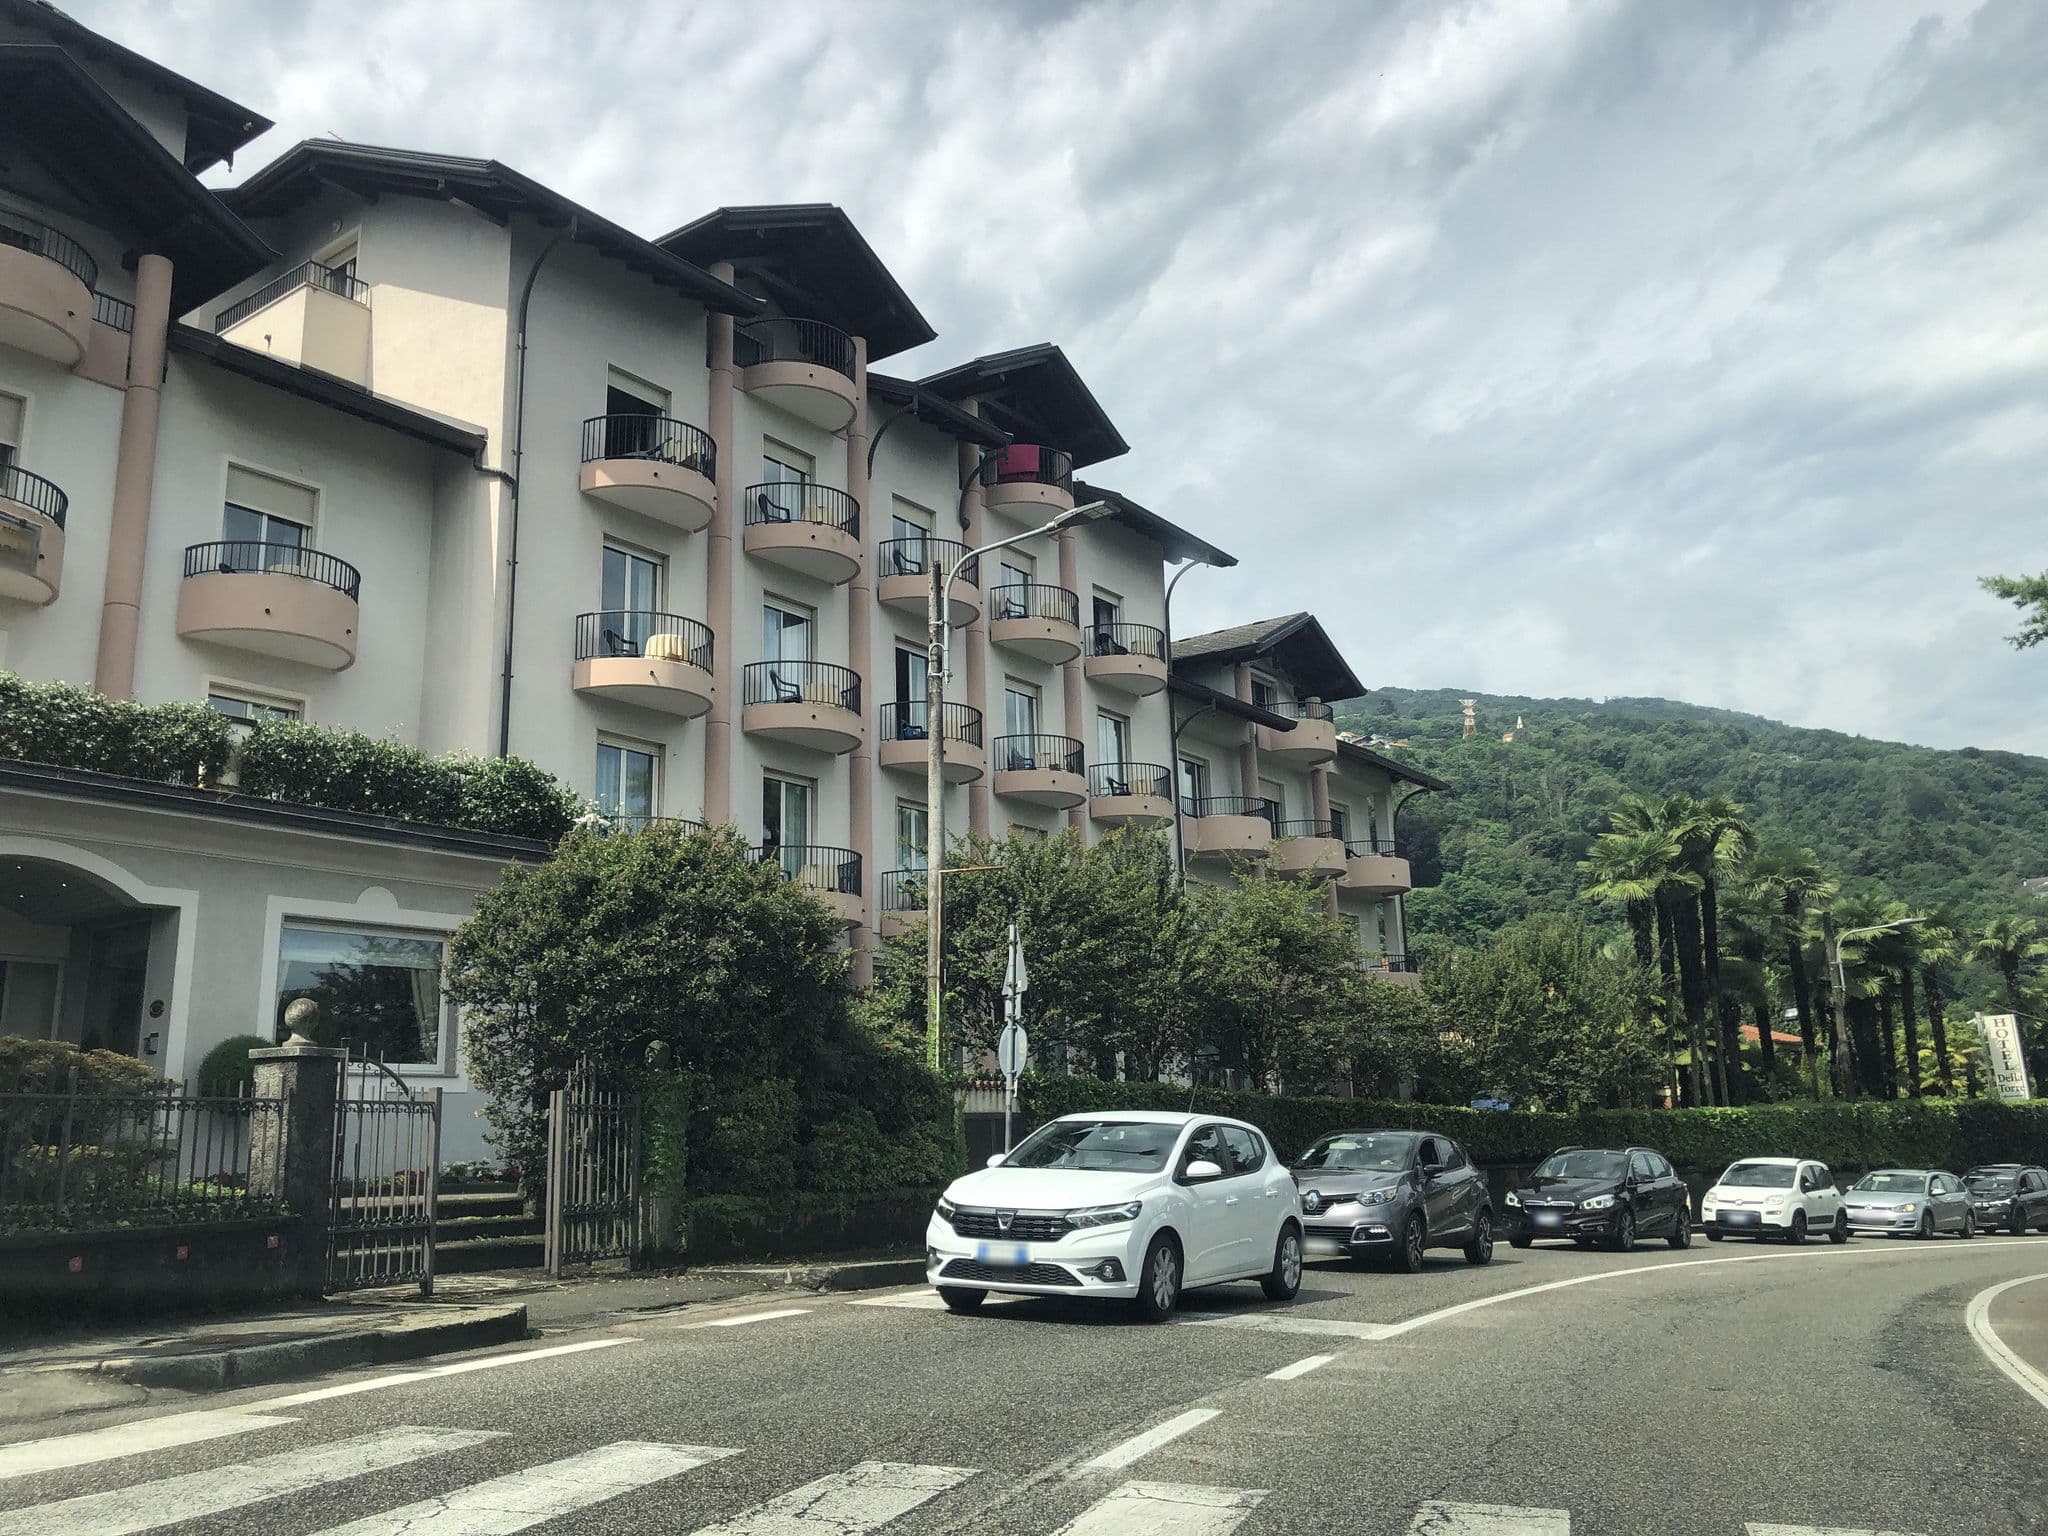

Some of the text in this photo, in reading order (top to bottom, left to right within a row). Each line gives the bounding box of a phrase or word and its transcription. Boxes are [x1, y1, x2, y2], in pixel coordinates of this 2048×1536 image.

[1993, 1018, 2014, 1070] HOTEL
[1997, 1073, 2023, 1083] Della
[1999, 1084, 2025, 1093] Torre
